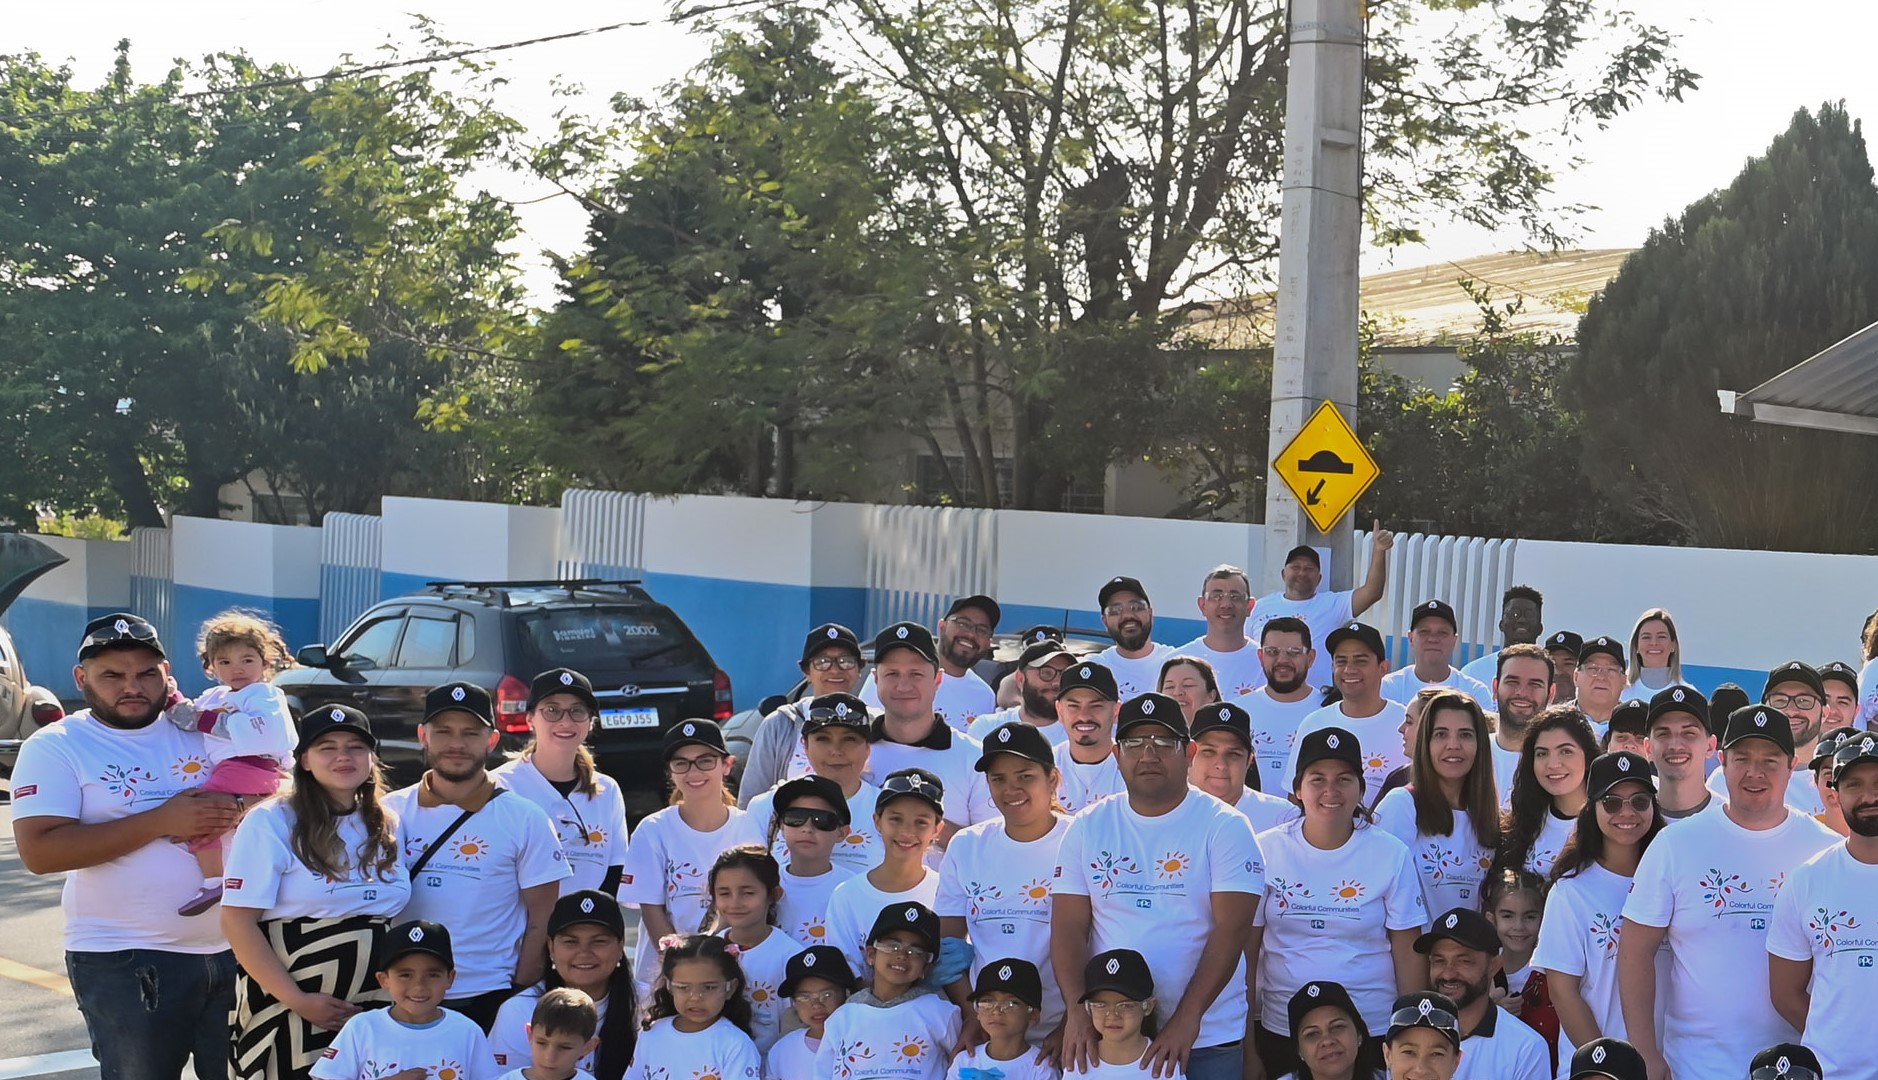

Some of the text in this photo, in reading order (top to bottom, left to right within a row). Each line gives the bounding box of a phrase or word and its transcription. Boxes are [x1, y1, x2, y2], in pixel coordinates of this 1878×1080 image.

[624, 625, 659, 635] 20012
[606, 714, 652, 725] EGC9J55
[1116, 882, 1142, 890] Colorful
[1729, 901, 1755, 909] Colorful
[1751, 918, 1765, 929] PPG
[1858, 955, 1873, 967] PPG
